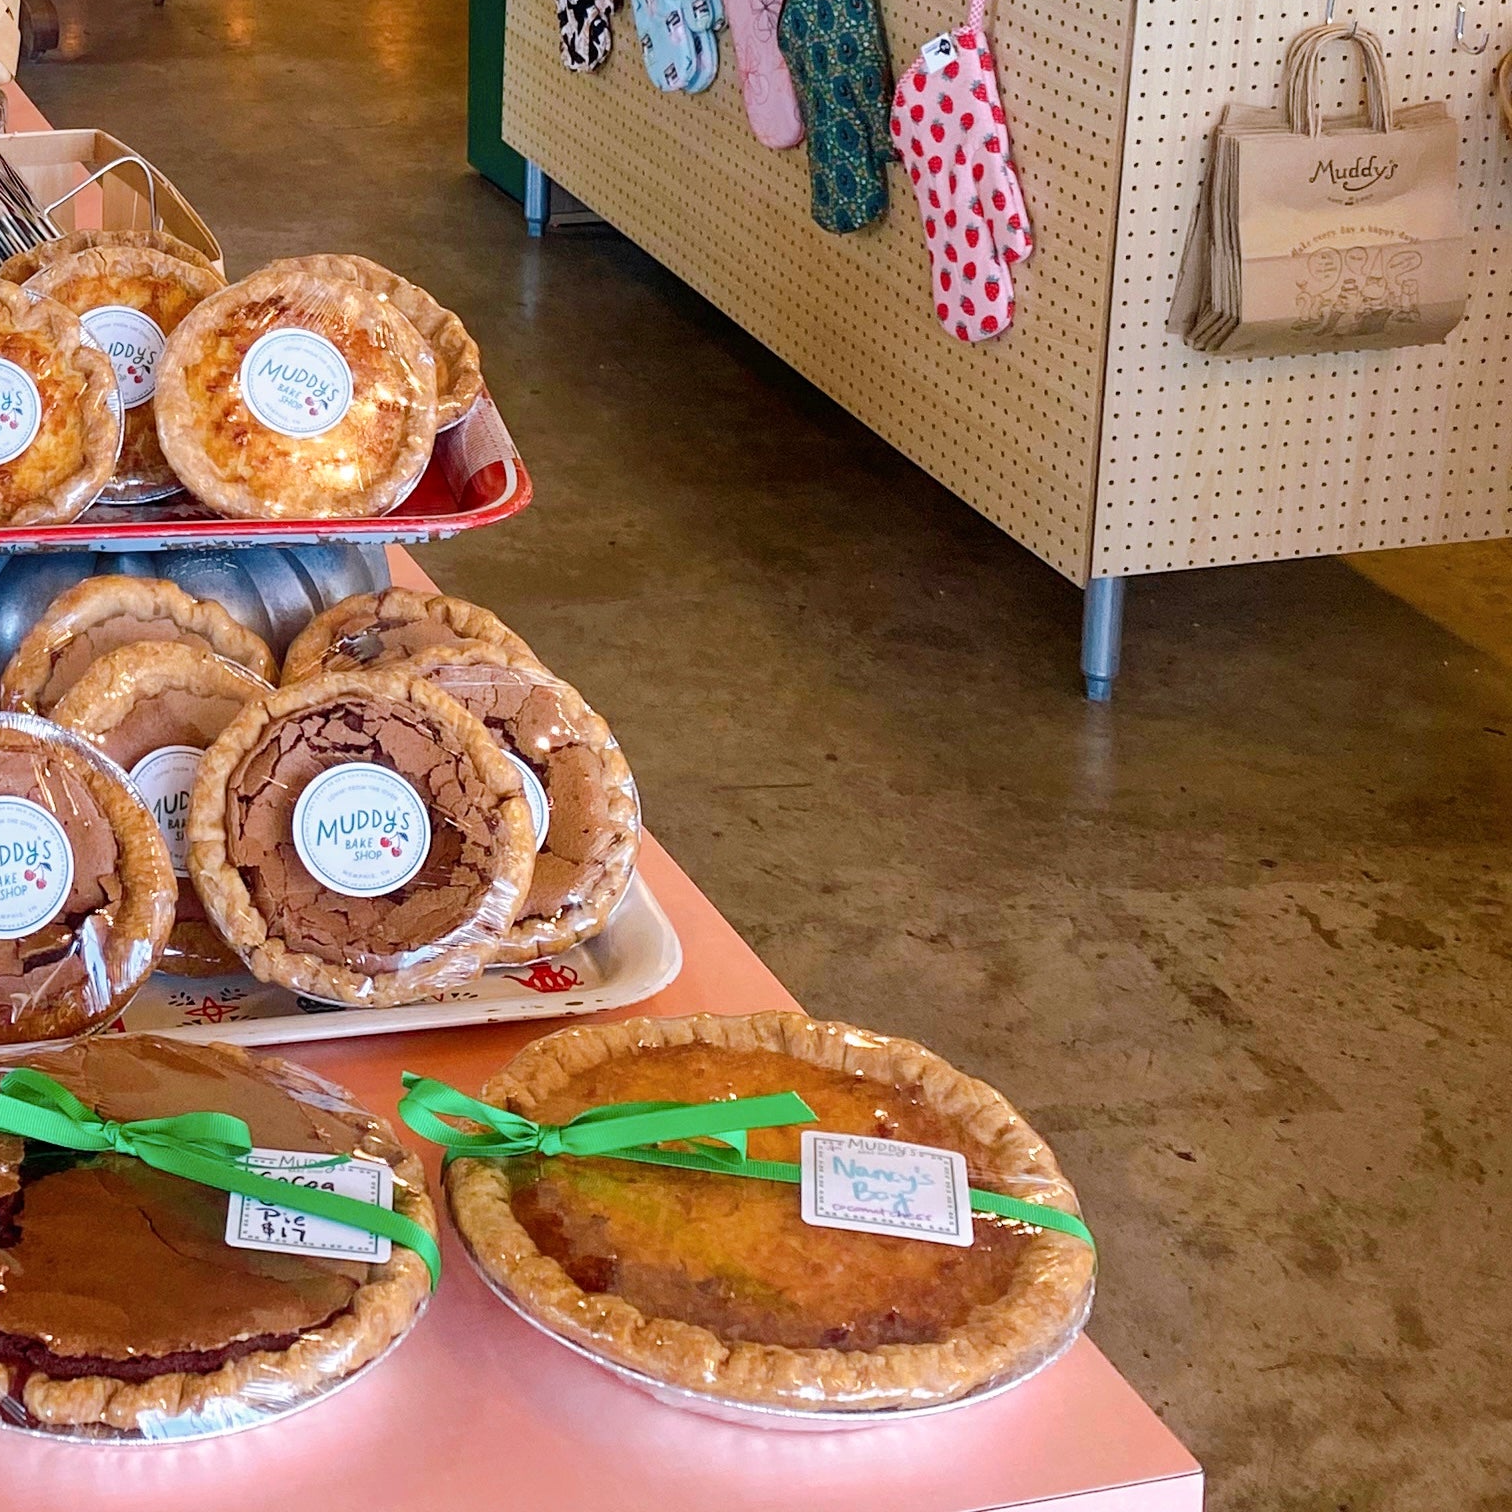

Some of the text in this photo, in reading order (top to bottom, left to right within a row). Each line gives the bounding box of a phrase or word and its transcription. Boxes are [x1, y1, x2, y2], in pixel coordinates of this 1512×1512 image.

[1309, 155, 1399, 191] Muddy's
[108, 341, 157, 365] DDY'S
[258, 358, 339, 402] MUDDY'S
[277, 384, 303, 398] BAKE
[279, 395, 303, 410] SHOP
[316, 806, 410, 846] MUDDY'S
[345, 837, 374, 850] BAKE
[353, 850, 383, 862] SHOP
[0, 885, 28, 901] SHOP
[847, 1138, 917, 1158] MUDDY'S
[255, 1207, 306, 1227] Pie
